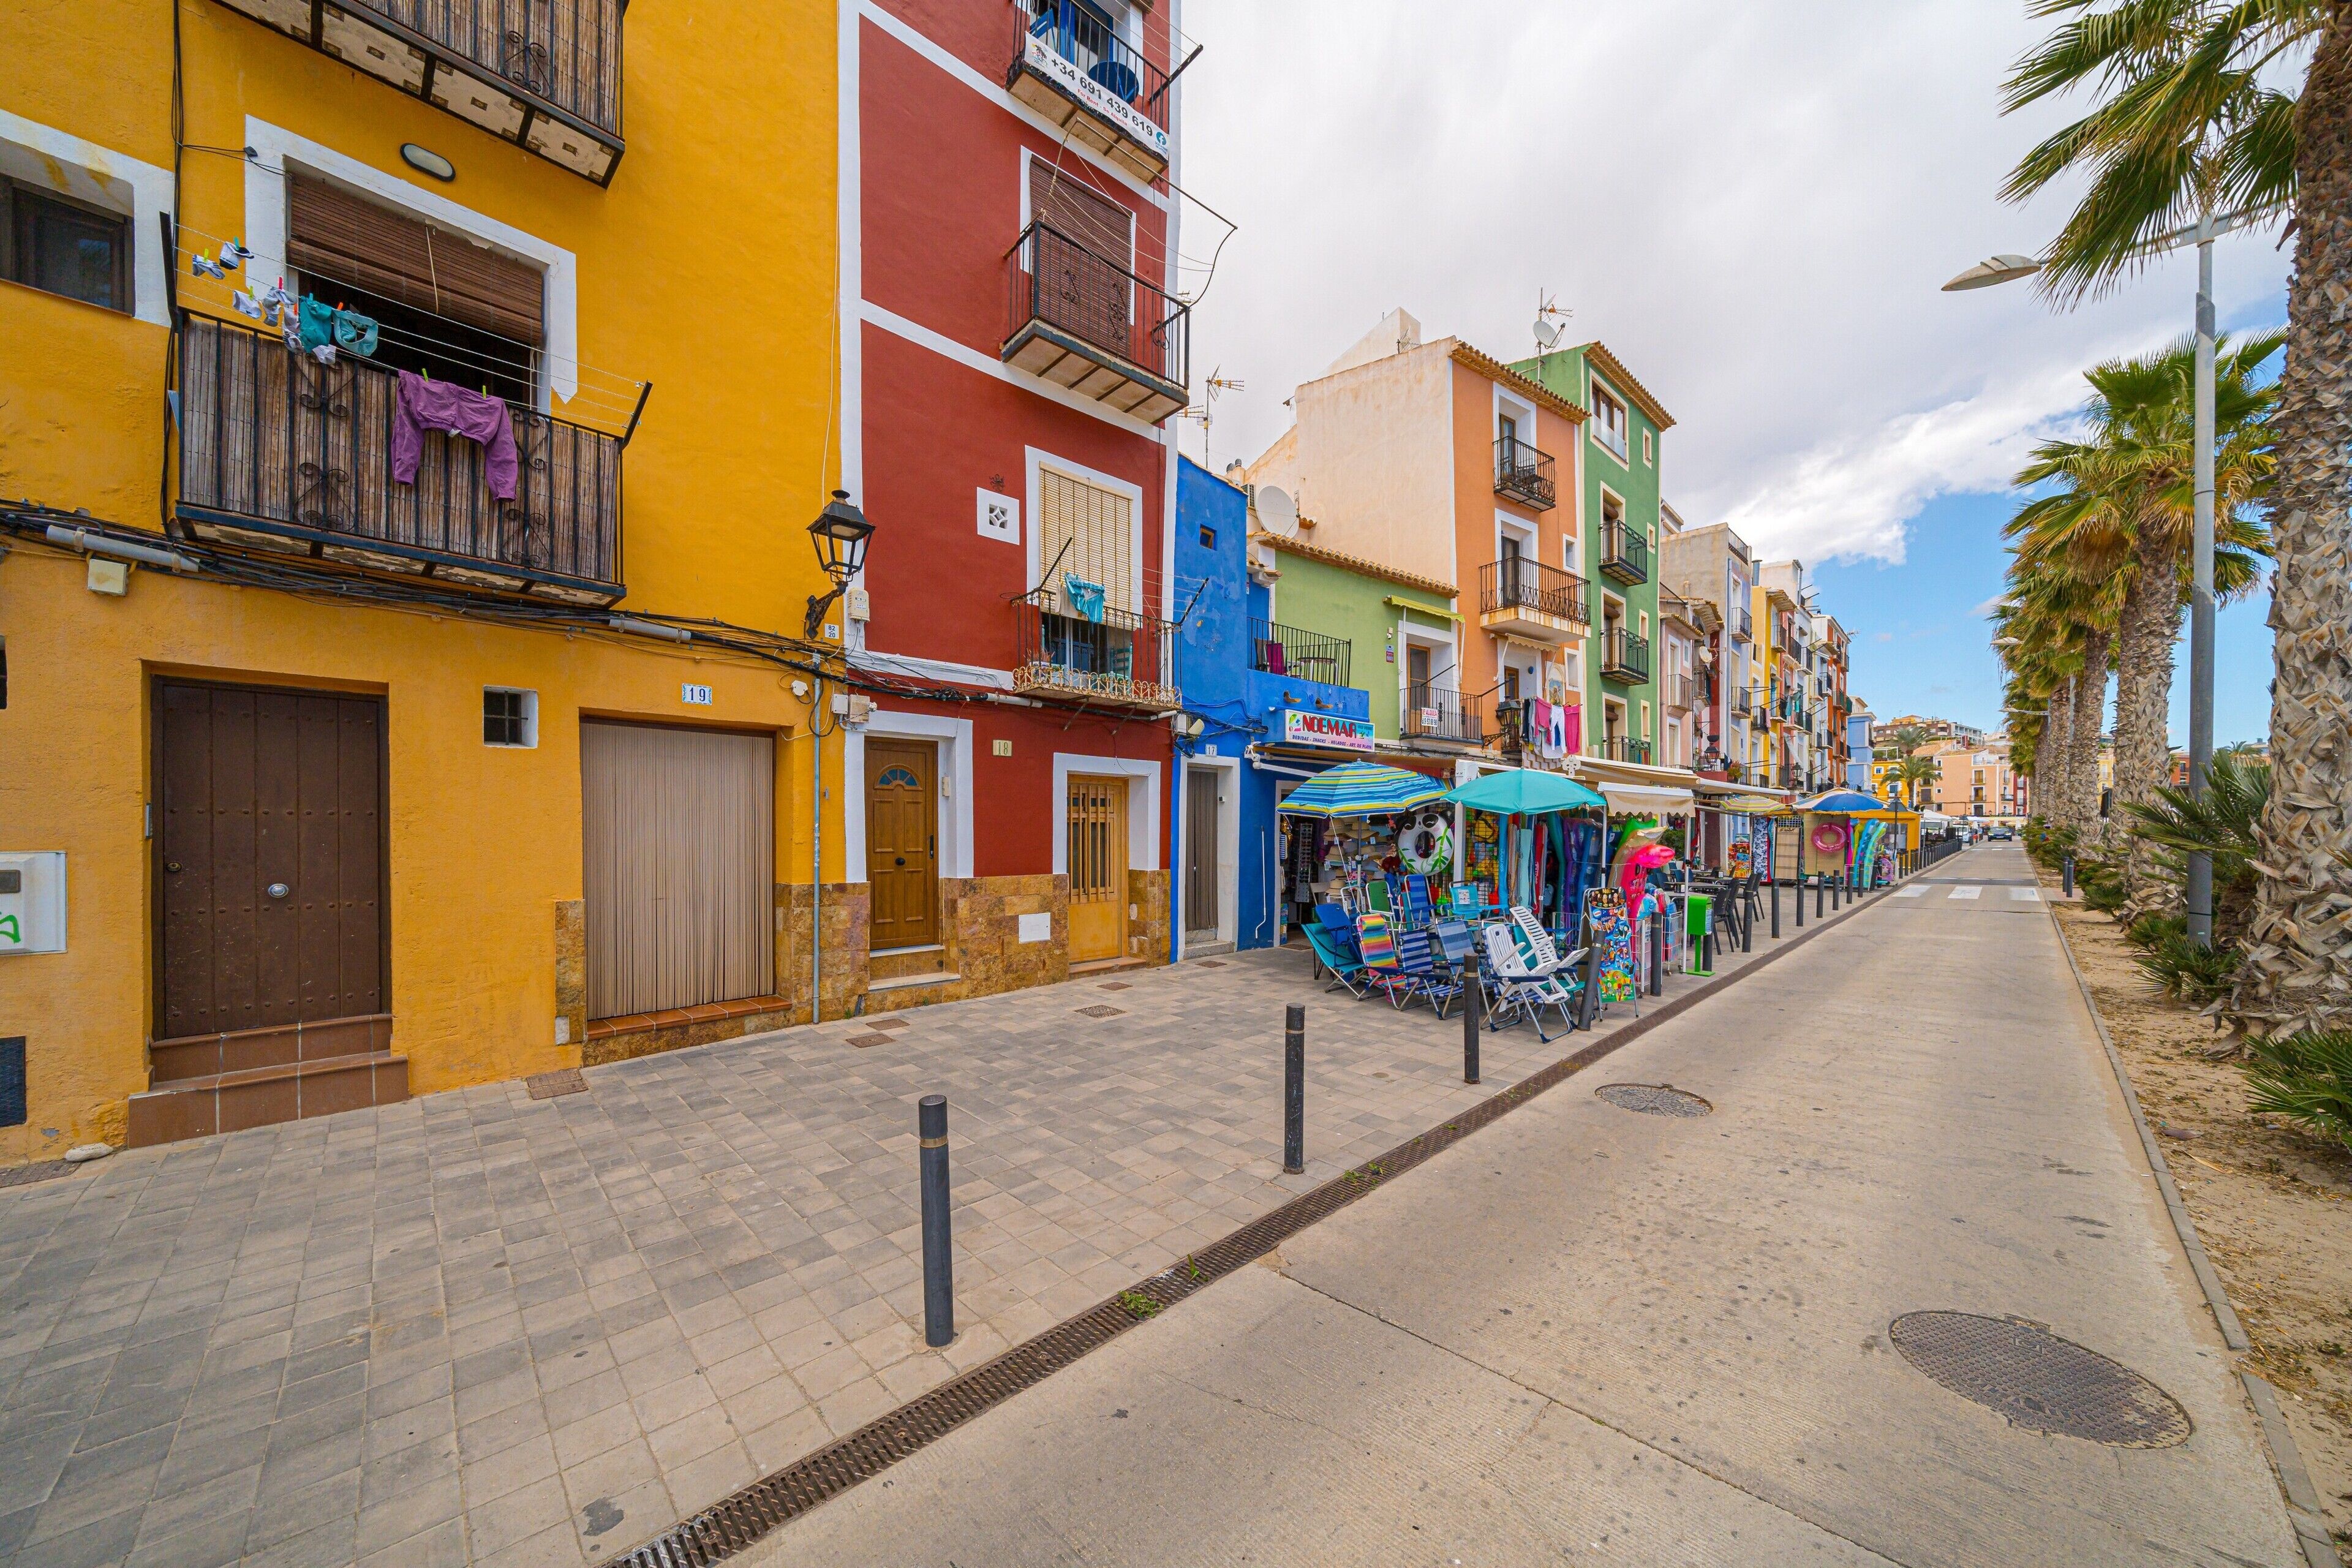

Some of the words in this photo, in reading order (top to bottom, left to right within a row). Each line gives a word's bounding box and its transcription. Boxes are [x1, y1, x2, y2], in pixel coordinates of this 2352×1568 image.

[1051, 58, 1076, 81] +34
[1079, 77, 1102, 100] 691
[1106, 97, 1128, 119] 439
[1132, 115, 1153, 137] 619
[1077, 88, 1086, 100] For
[1087, 96, 1099, 107] Rent
[690, 687, 706, 701] 19
[1302, 714, 1357, 739] NOEMAR
[998, 741, 1008, 755] 18
[1208, 746, 1215, 755] 17
